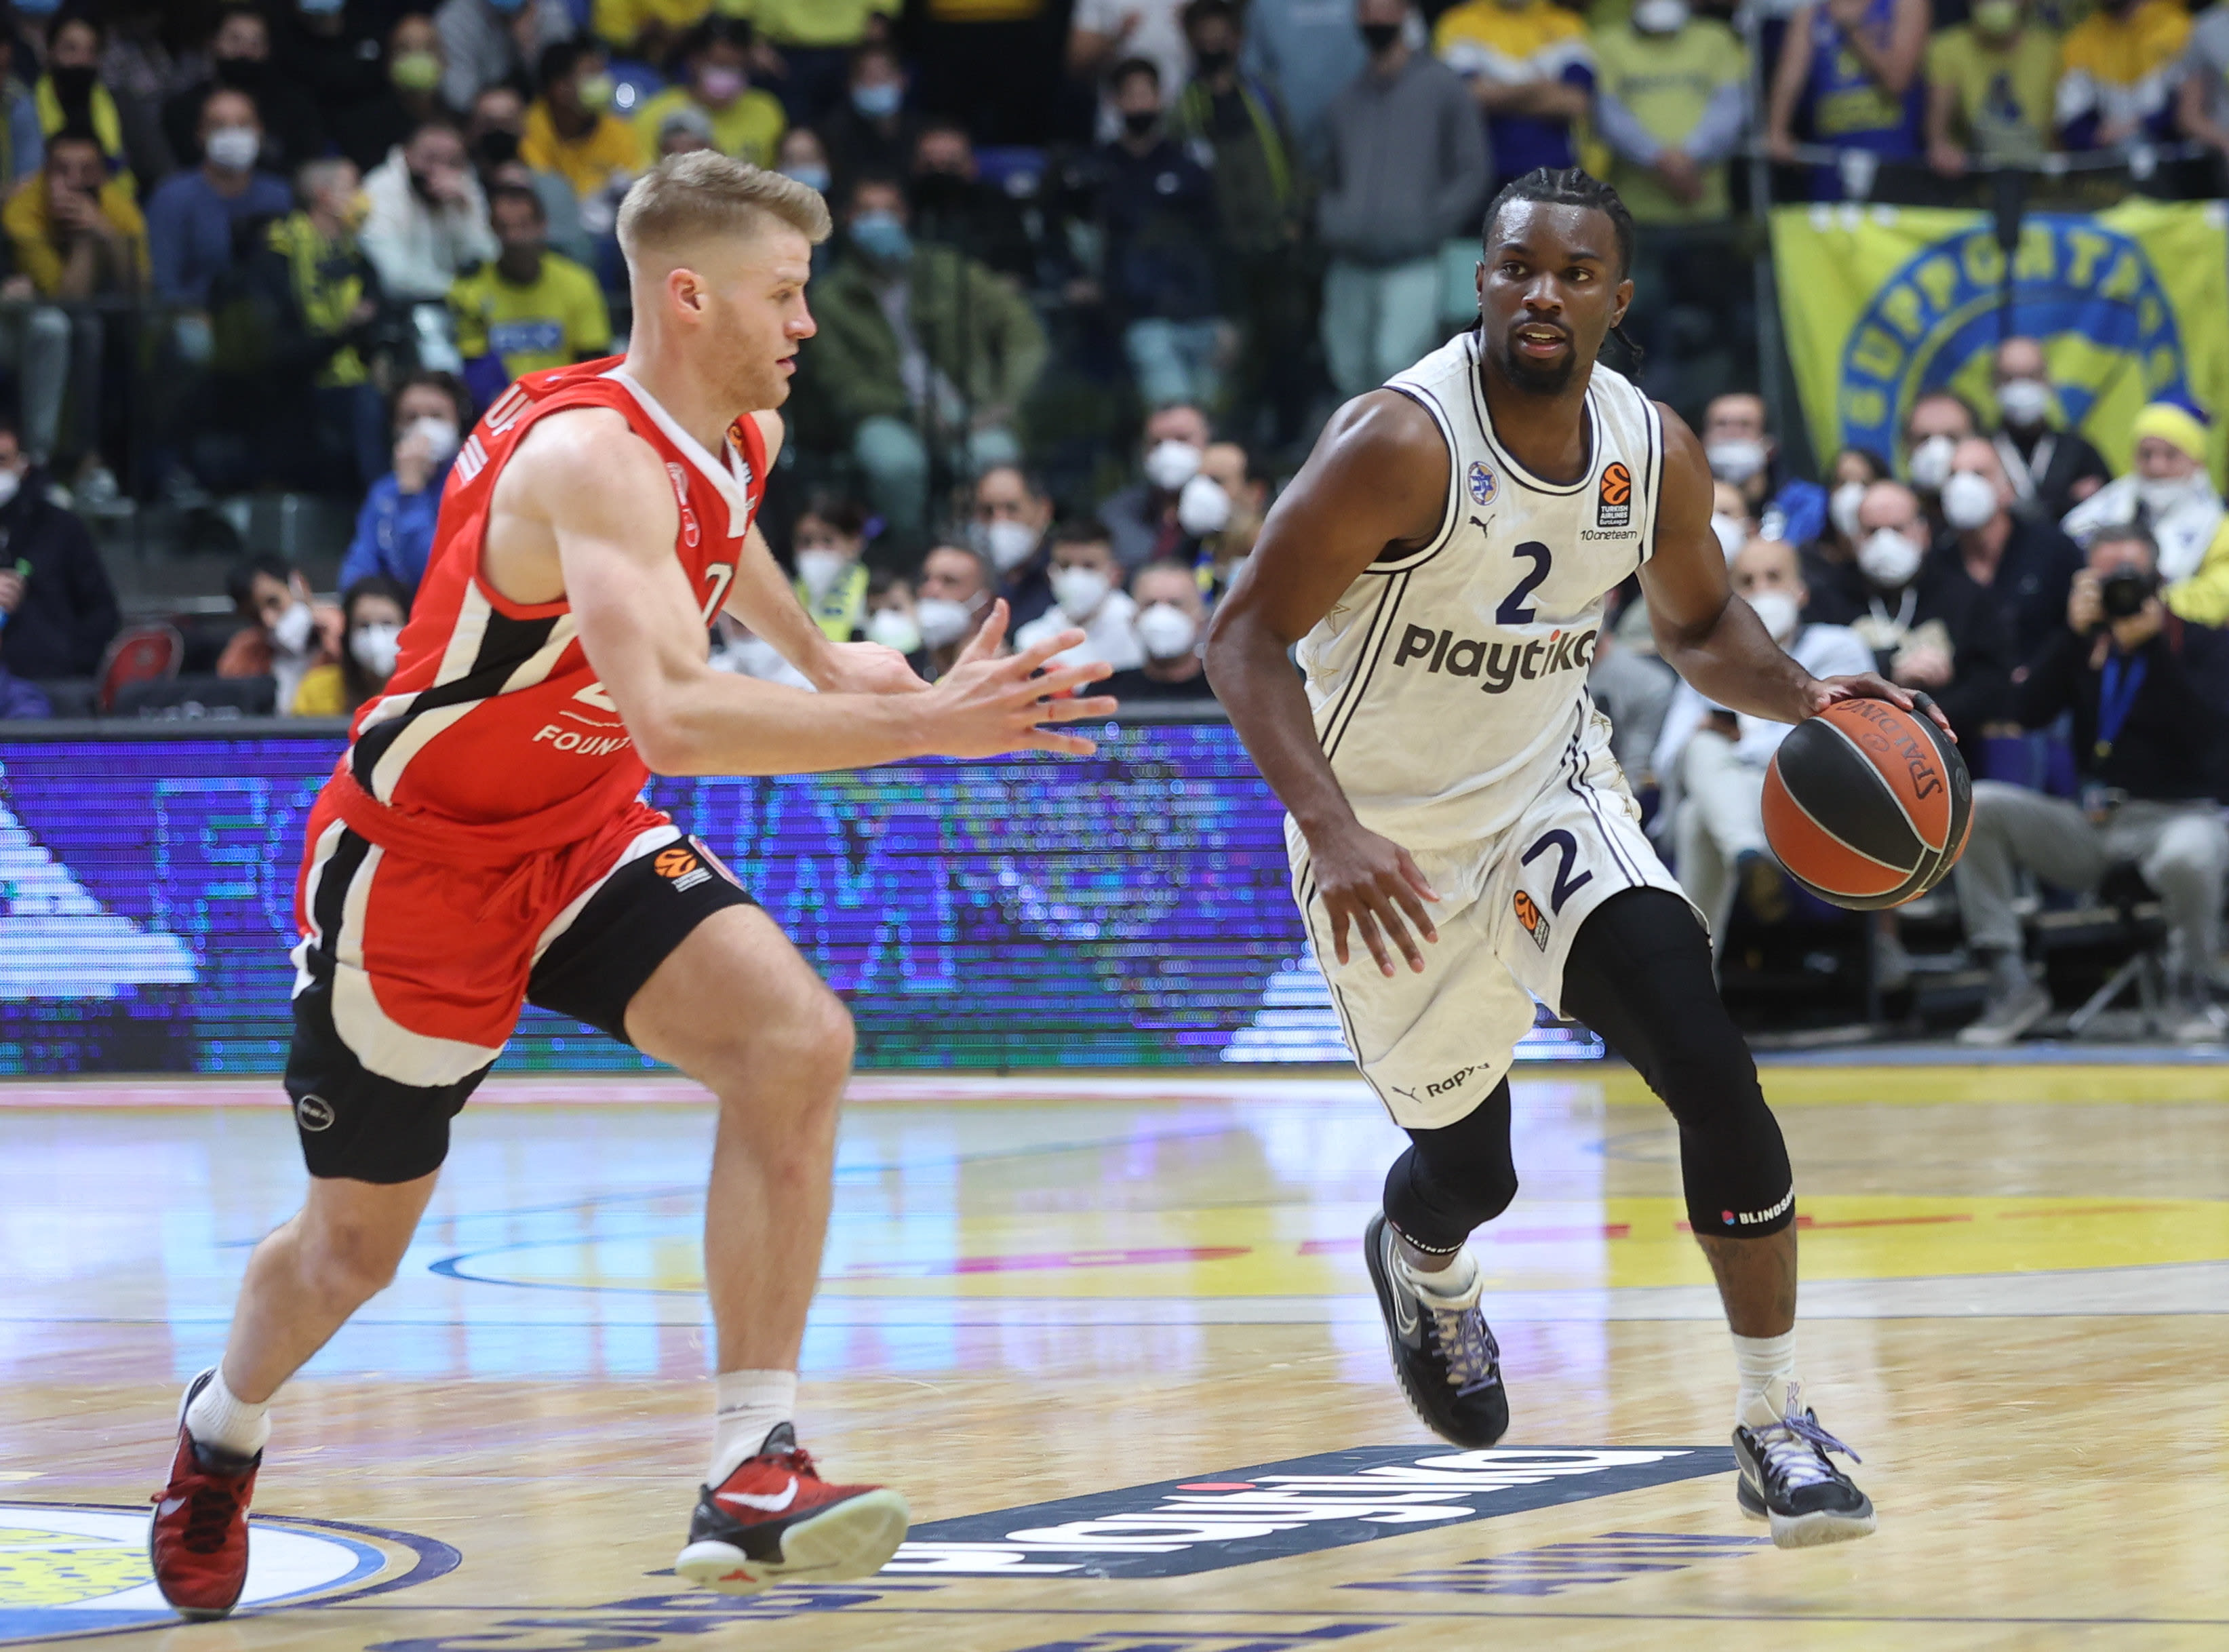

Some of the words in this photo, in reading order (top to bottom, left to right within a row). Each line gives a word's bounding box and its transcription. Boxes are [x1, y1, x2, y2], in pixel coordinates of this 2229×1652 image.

[1496, 541, 1552, 625] 2
[1836, 699, 1943, 800] SPALDING
[1521, 829, 1593, 916] 2
